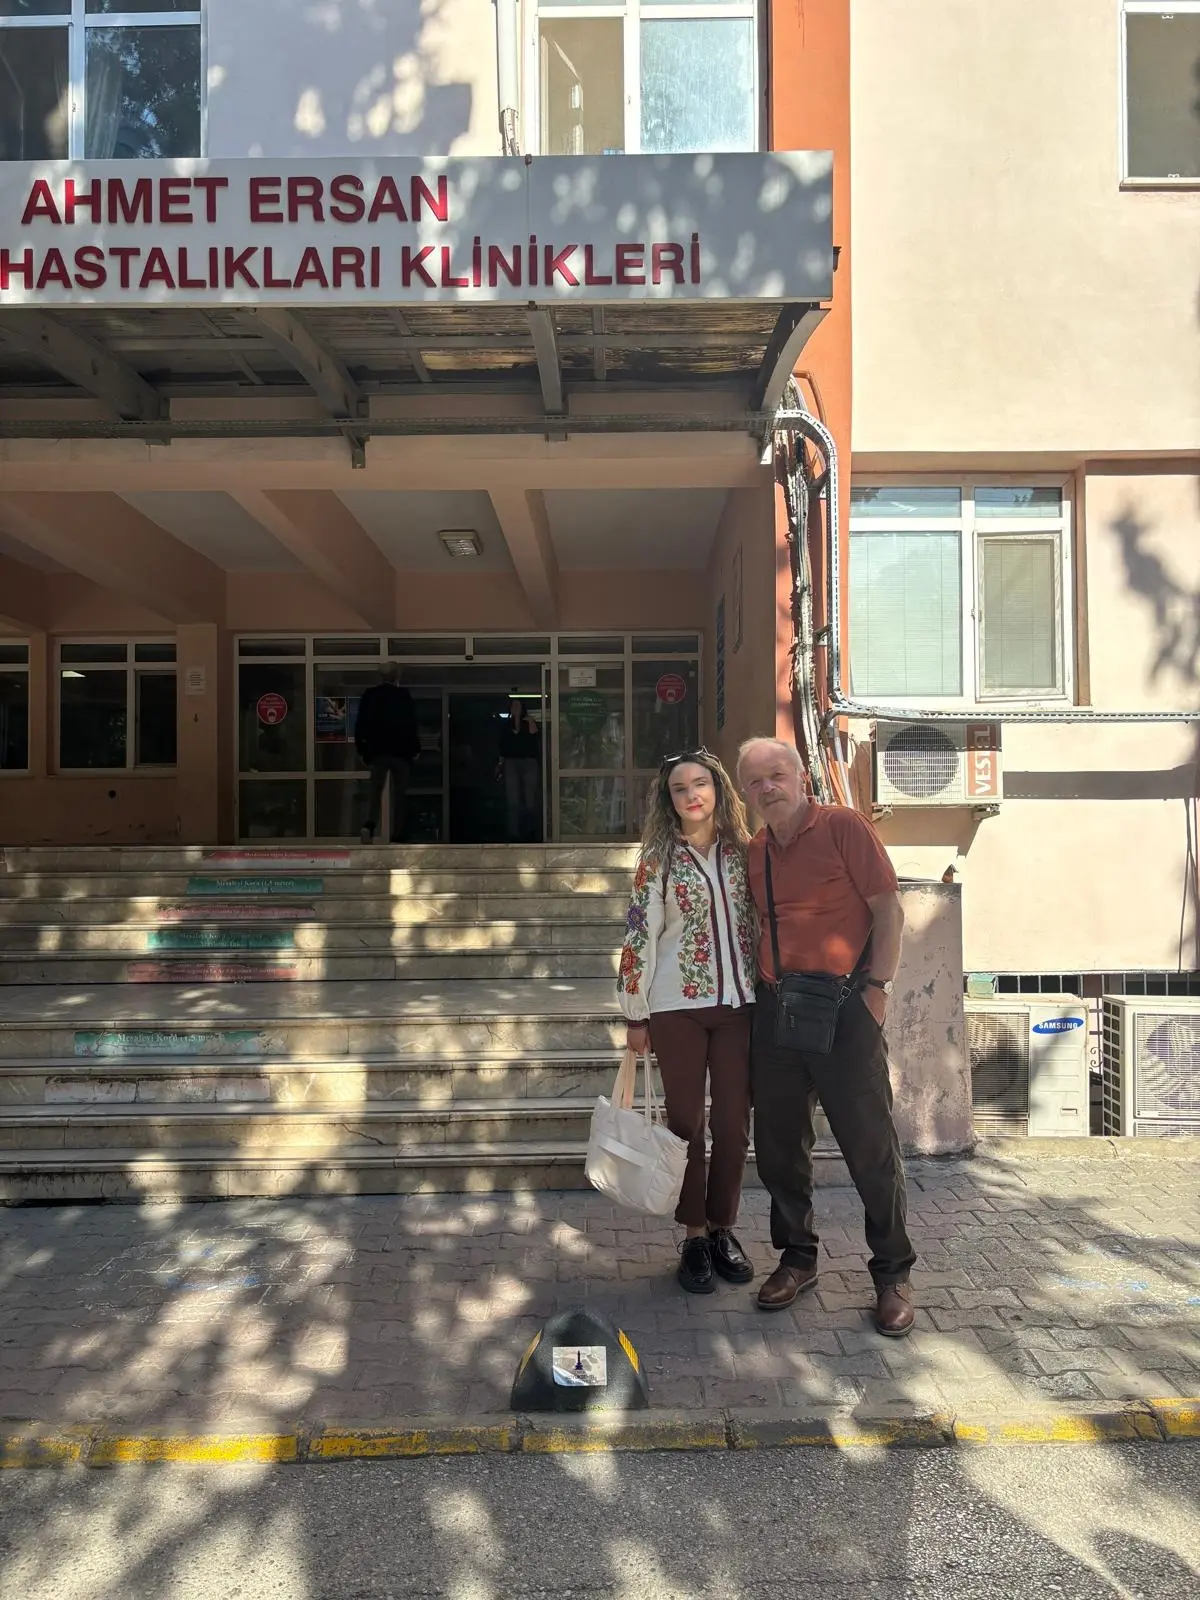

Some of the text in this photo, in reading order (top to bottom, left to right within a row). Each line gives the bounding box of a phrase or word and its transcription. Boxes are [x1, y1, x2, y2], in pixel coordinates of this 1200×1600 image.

[21, 174, 448, 225] AHMET ERSAN
[0, 232, 700, 290] HASTALIKLARI KLİNİKLERİ
[1039, 1022, 1078, 1030] SAMSUNG
